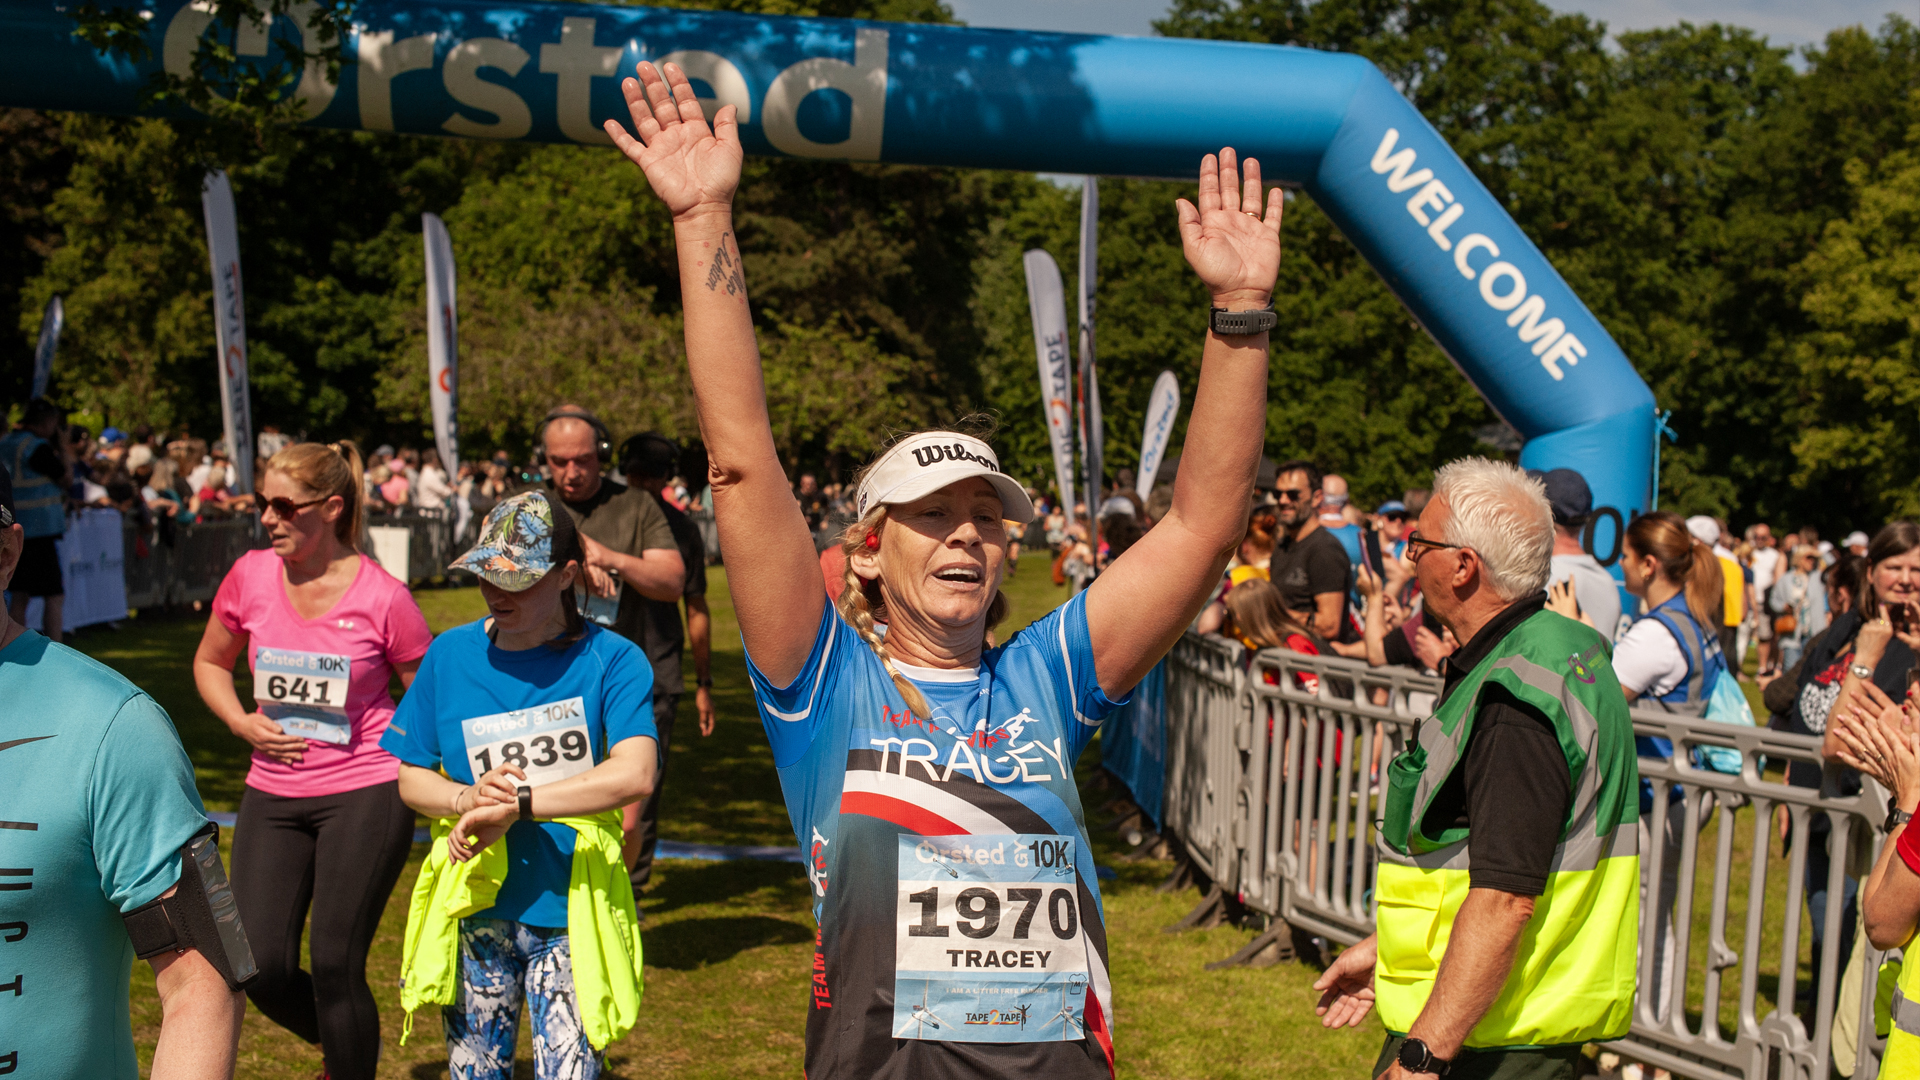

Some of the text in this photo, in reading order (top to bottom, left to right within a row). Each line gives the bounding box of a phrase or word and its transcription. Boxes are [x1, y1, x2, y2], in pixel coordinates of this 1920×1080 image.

[1370, 127, 1588, 381] WELCOME
[912, 443, 998, 472] Wilson
[262, 650, 304, 667] Ørsted
[318, 657, 345, 672] 10K
[268, 675, 331, 705] 641
[472, 714, 527, 736] Ørsted
[543, 701, 580, 723] 10K
[475, 730, 588, 778] 1839
[870, 736, 1068, 784] TRACEY
[915, 840, 1069, 868] Ørsted GY 10K
[908, 886, 1078, 941] 1970
[946, 949, 1052, 968] TRACEY
[813, 952, 833, 1010] TEAM
